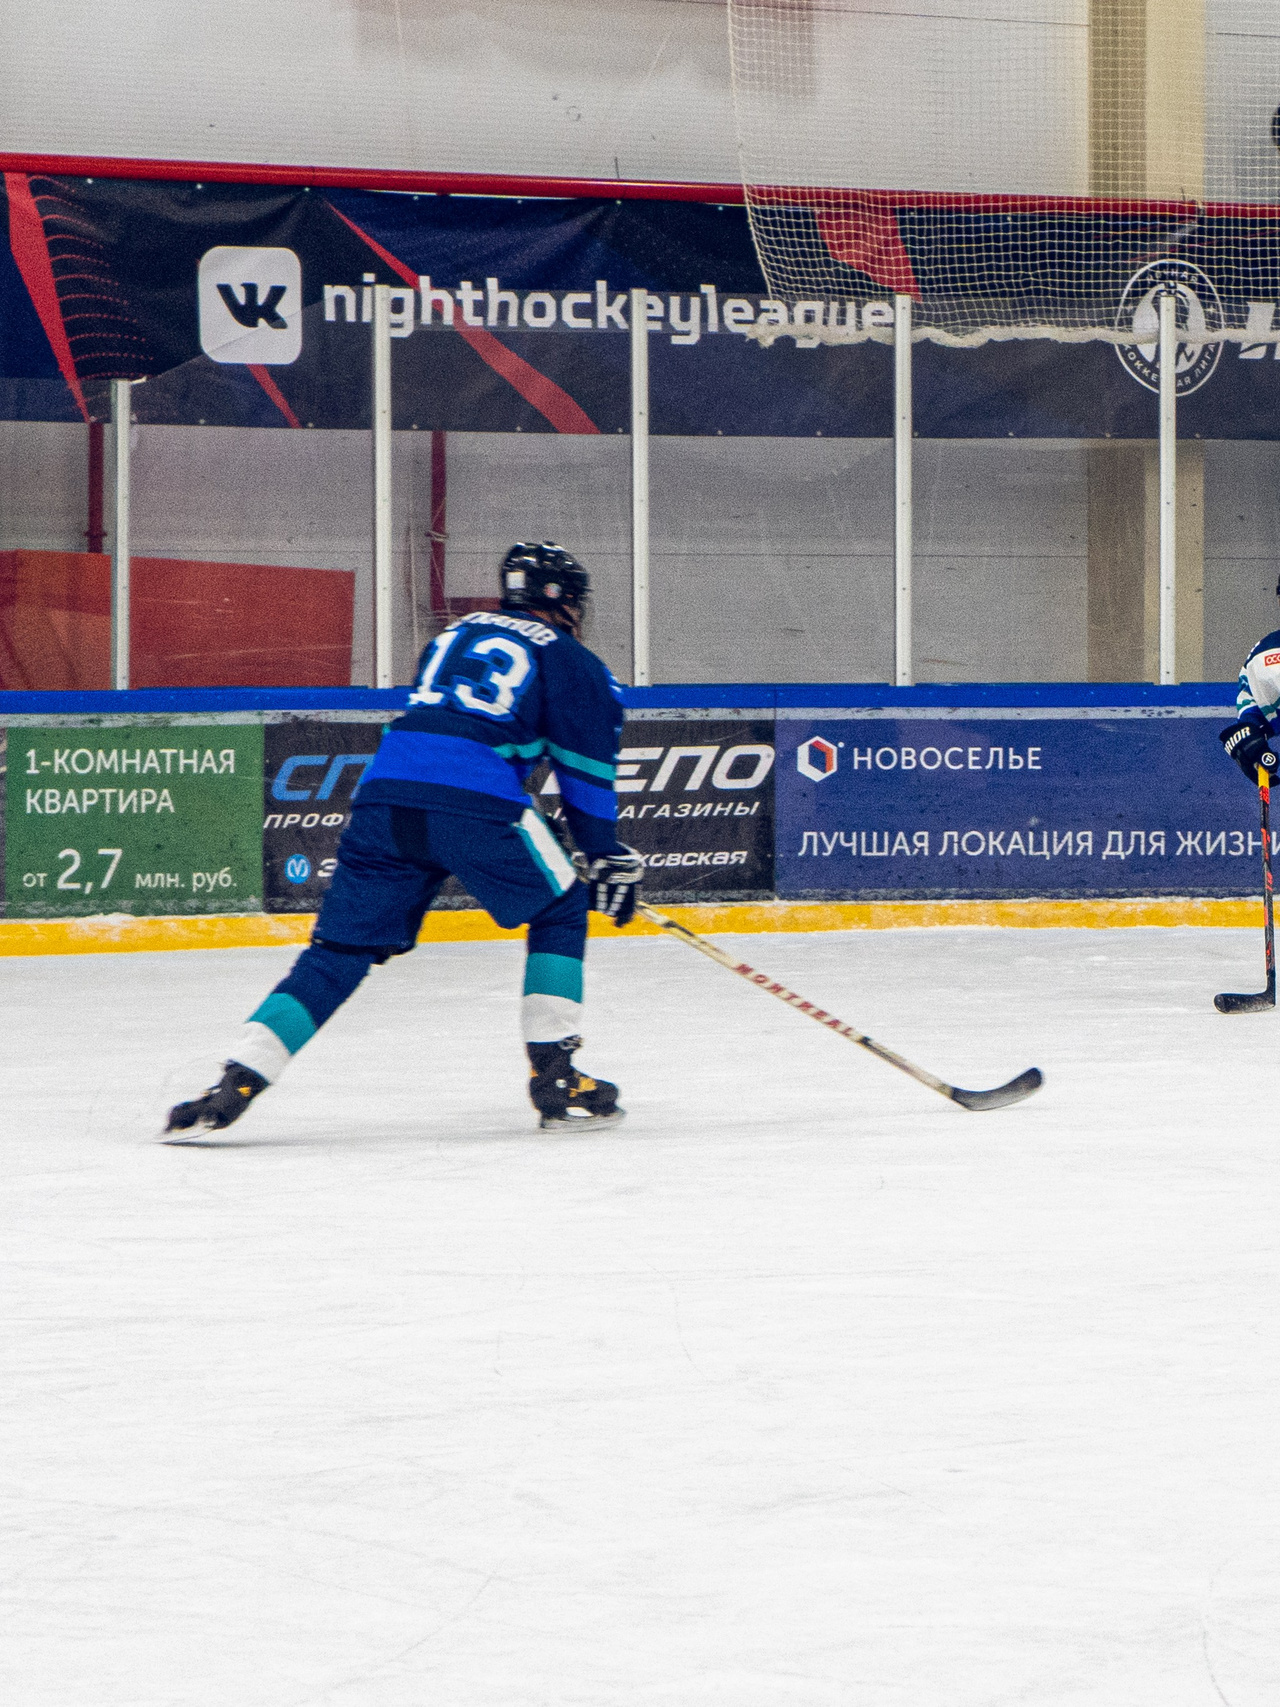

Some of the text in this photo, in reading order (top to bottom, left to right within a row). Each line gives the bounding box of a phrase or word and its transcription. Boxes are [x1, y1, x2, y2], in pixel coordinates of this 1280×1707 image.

[407, 629, 535, 718] 13
[25, 748, 236, 775] 1-КОМНАТНАЯ
[271, 754, 375, 801] СП
[614, 744, 776, 792] ЕПО
[853, 747, 1043, 771] НОВОСЕЛЬЕ
[25, 788, 175, 814] КВАРТИРА
[263, 801, 760, 829] ПРОФ АГАЗИНЫ
[798, 830, 930, 857] ЛУЧШАЯ
[938, 830, 1094, 860] ЛОКАЦИЯ
[1101, 830, 1166, 860] ДЛЯ
[23, 848, 237, 894] от 2,7 млн. руб.
[734, 962, 856, 1038] MONTREAL
